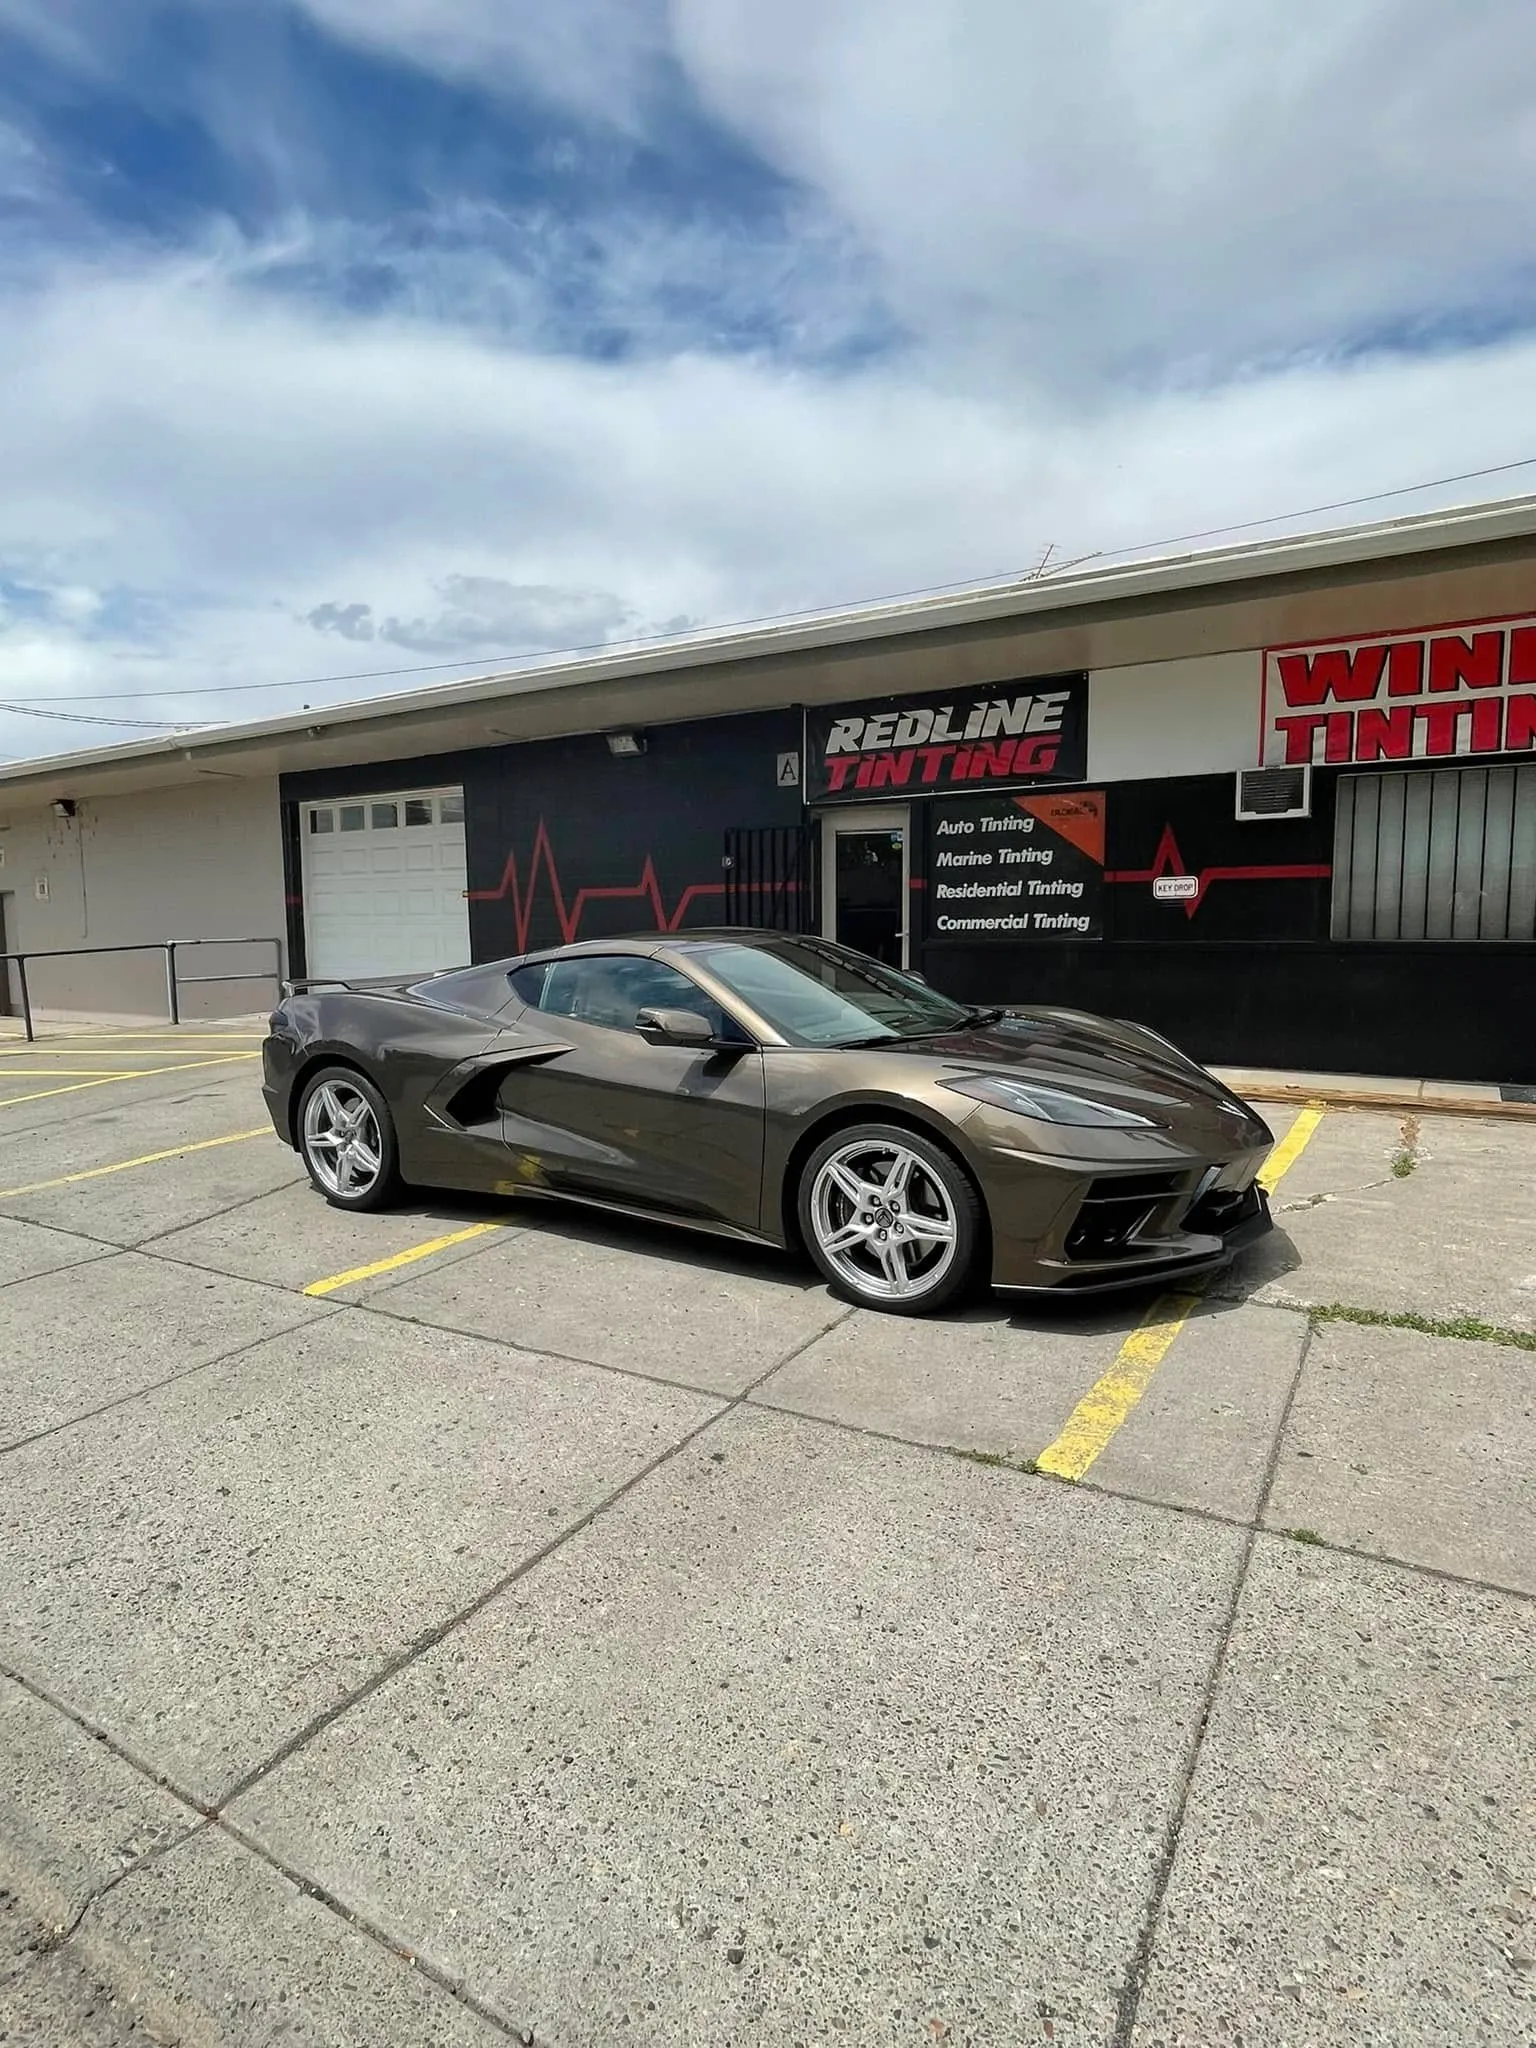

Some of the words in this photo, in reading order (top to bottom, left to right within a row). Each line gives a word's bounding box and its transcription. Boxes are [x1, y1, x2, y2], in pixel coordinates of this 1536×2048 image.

[824, 691, 1071, 755] REDLINE
[780, 757, 797, 781] A
[824, 734, 1063, 792] TINTING
[936, 820, 975, 836] Auto
[980, 815, 1035, 833] Tinting
[936, 850, 993, 867] Marine
[998, 847, 1054, 865] Tinting
[936, 880, 1023, 899] Residential
[1027, 879, 1084, 898] Tinting
[1158, 884, 1173, 892] KEY
[1174, 883, 1194, 892] DROP
[936, 913, 1029, 930] Commercial
[1033, 912, 1091, 932] Tinting
